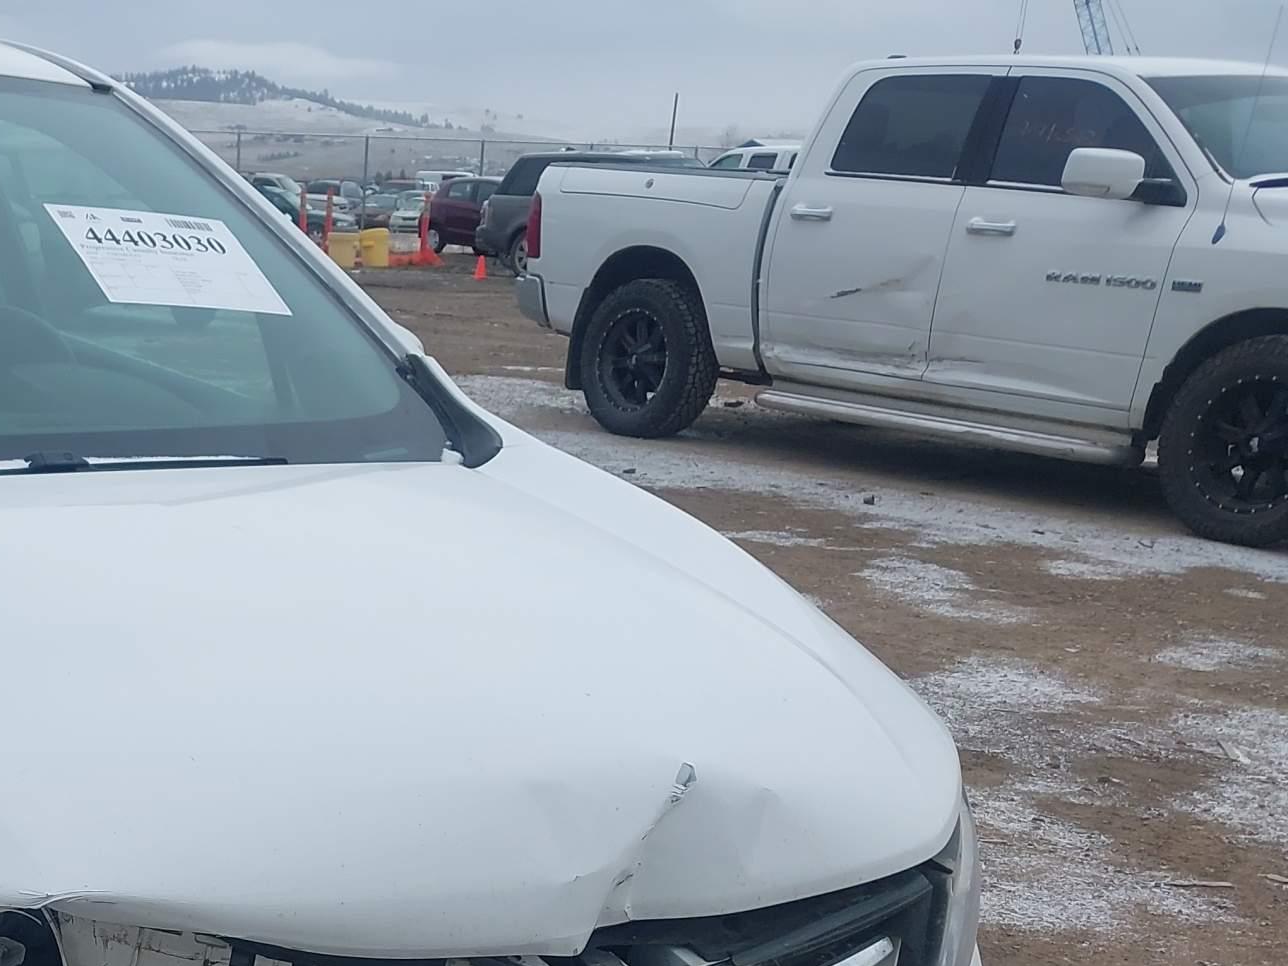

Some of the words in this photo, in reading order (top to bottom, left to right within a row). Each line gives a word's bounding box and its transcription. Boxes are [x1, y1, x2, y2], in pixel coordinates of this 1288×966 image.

[85, 227, 227, 255] 44403030
[1045, 271, 1101, 286] RAM
[1105, 274, 1157, 290] 1500
